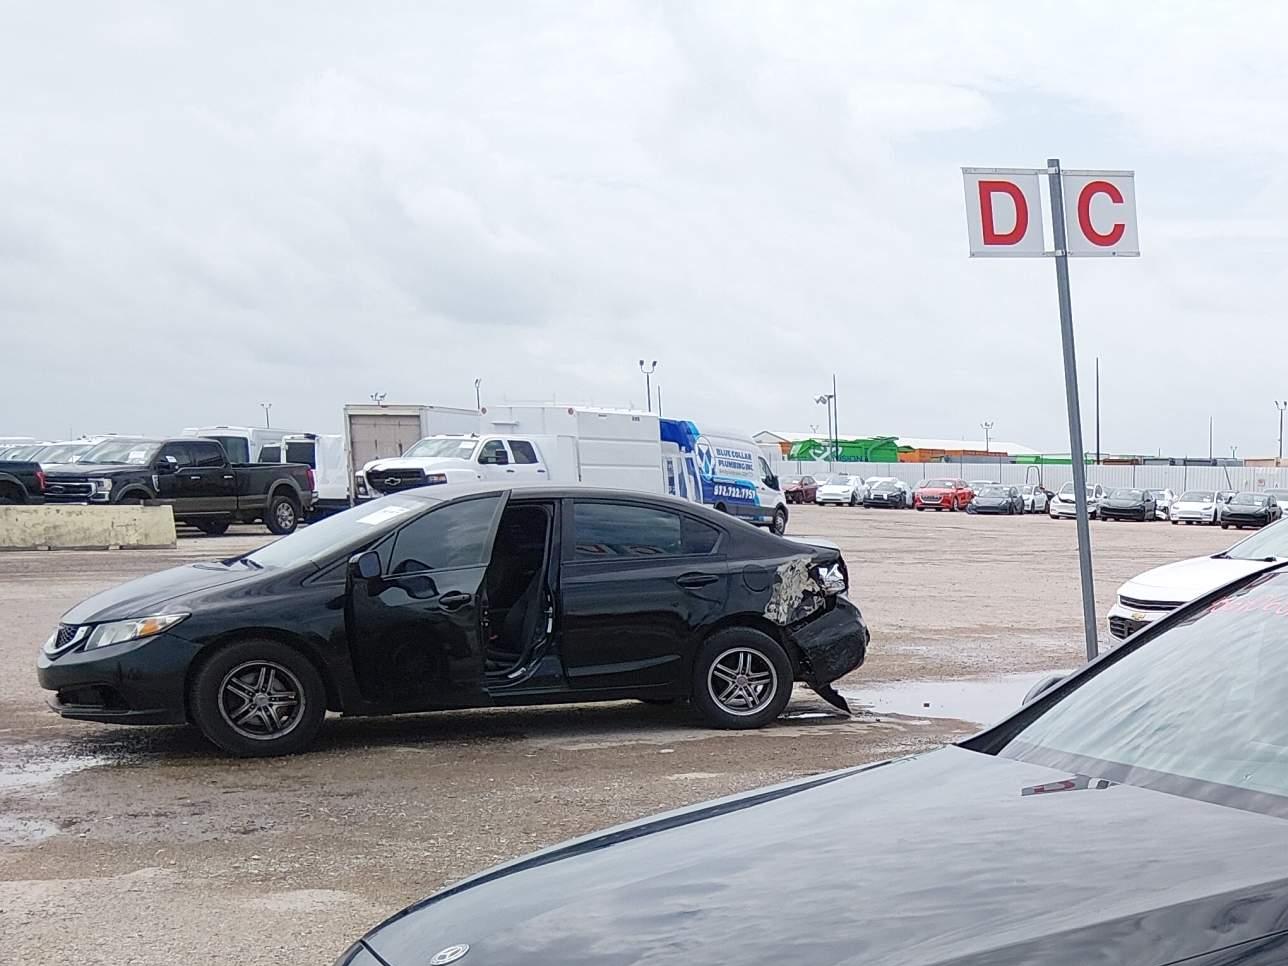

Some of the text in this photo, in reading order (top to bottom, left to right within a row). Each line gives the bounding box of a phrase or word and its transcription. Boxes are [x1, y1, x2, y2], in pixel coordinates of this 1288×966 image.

[978, 180, 1029, 246] D
[1077, 180, 1126, 247] C
[716, 448, 752, 460] BLUE COLLAR
[718, 459, 745, 470] PLUMBING
